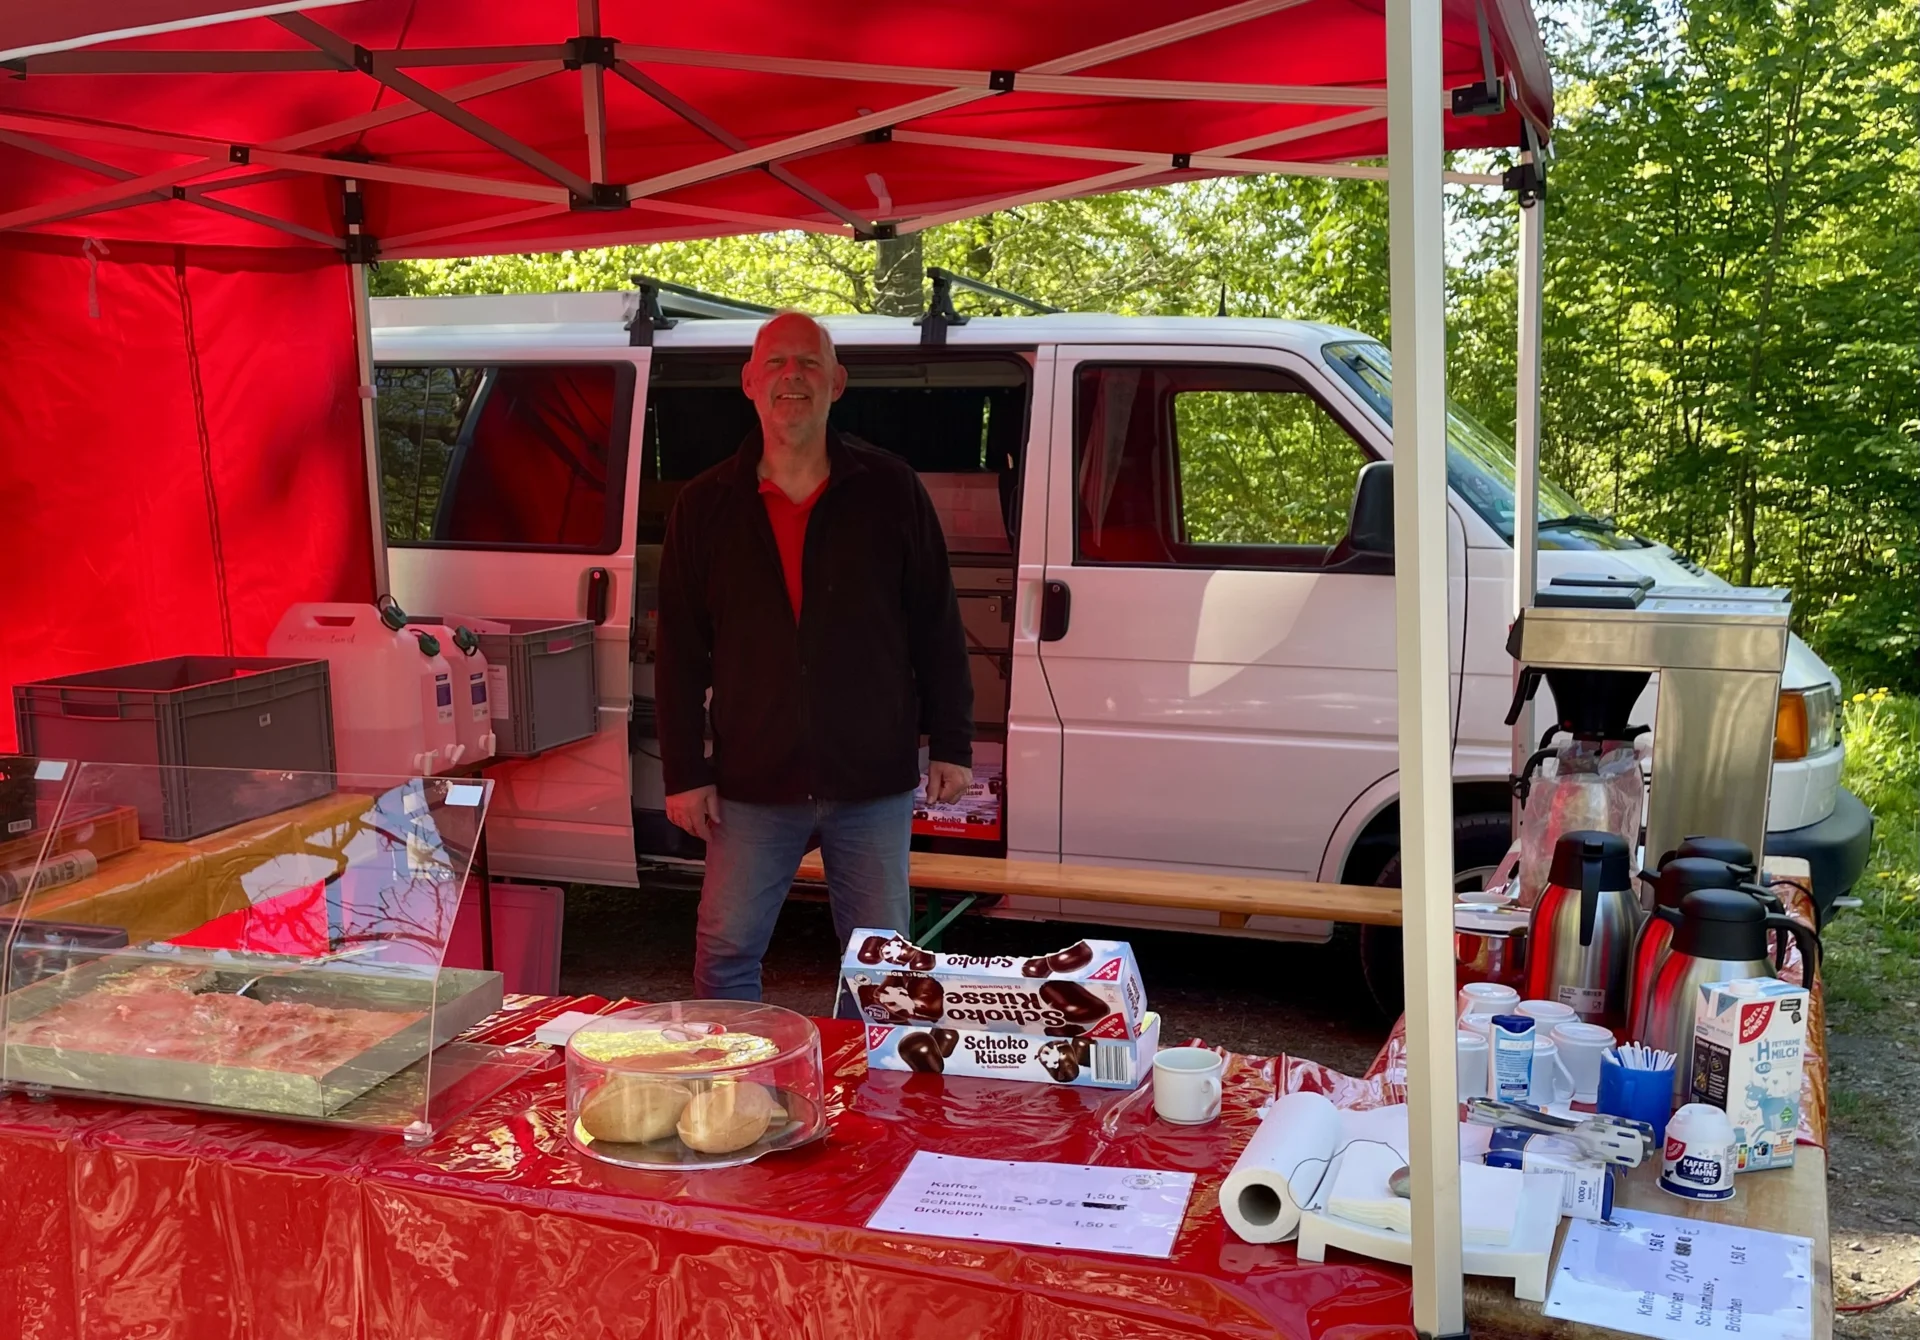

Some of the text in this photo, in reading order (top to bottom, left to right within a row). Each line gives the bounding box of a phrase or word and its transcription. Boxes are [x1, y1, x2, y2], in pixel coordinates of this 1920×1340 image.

[945, 991, 1042, 1010] Küsse
[946, 1008, 1066, 1027] Schoko
[1742, 1005, 1770, 1038] GÜNSTIG
[964, 1035, 1028, 1050] Schoko
[974, 1050, 1027, 1064] Küsse
[1757, 1041, 1770, 1061] H
[1772, 1047, 1799, 1060] MILCH
[1683, 1159, 1718, 1170] KAFFEE-
[1689, 1167, 1718, 1177] SAHNE
[930, 1181, 978, 1190] Kaffee
[925, 1189, 982, 1199] Kuchen
[1578, 1187, 1586, 1203] 1000
[914, 1206, 984, 1217] Brötchen
[920, 1197, 1023, 1212] Schaumkuss-
[1729, 1251, 1748, 1264] 1,50
[1636, 1290, 1655, 1316] Kaffee
[1649, 1238, 1665, 1252] 1,50
[1665, 1260, 1694, 1283] 2,00
[1665, 1292, 1684, 1321] Kuchen
[1725, 1298, 1742, 1332] Brötchen
